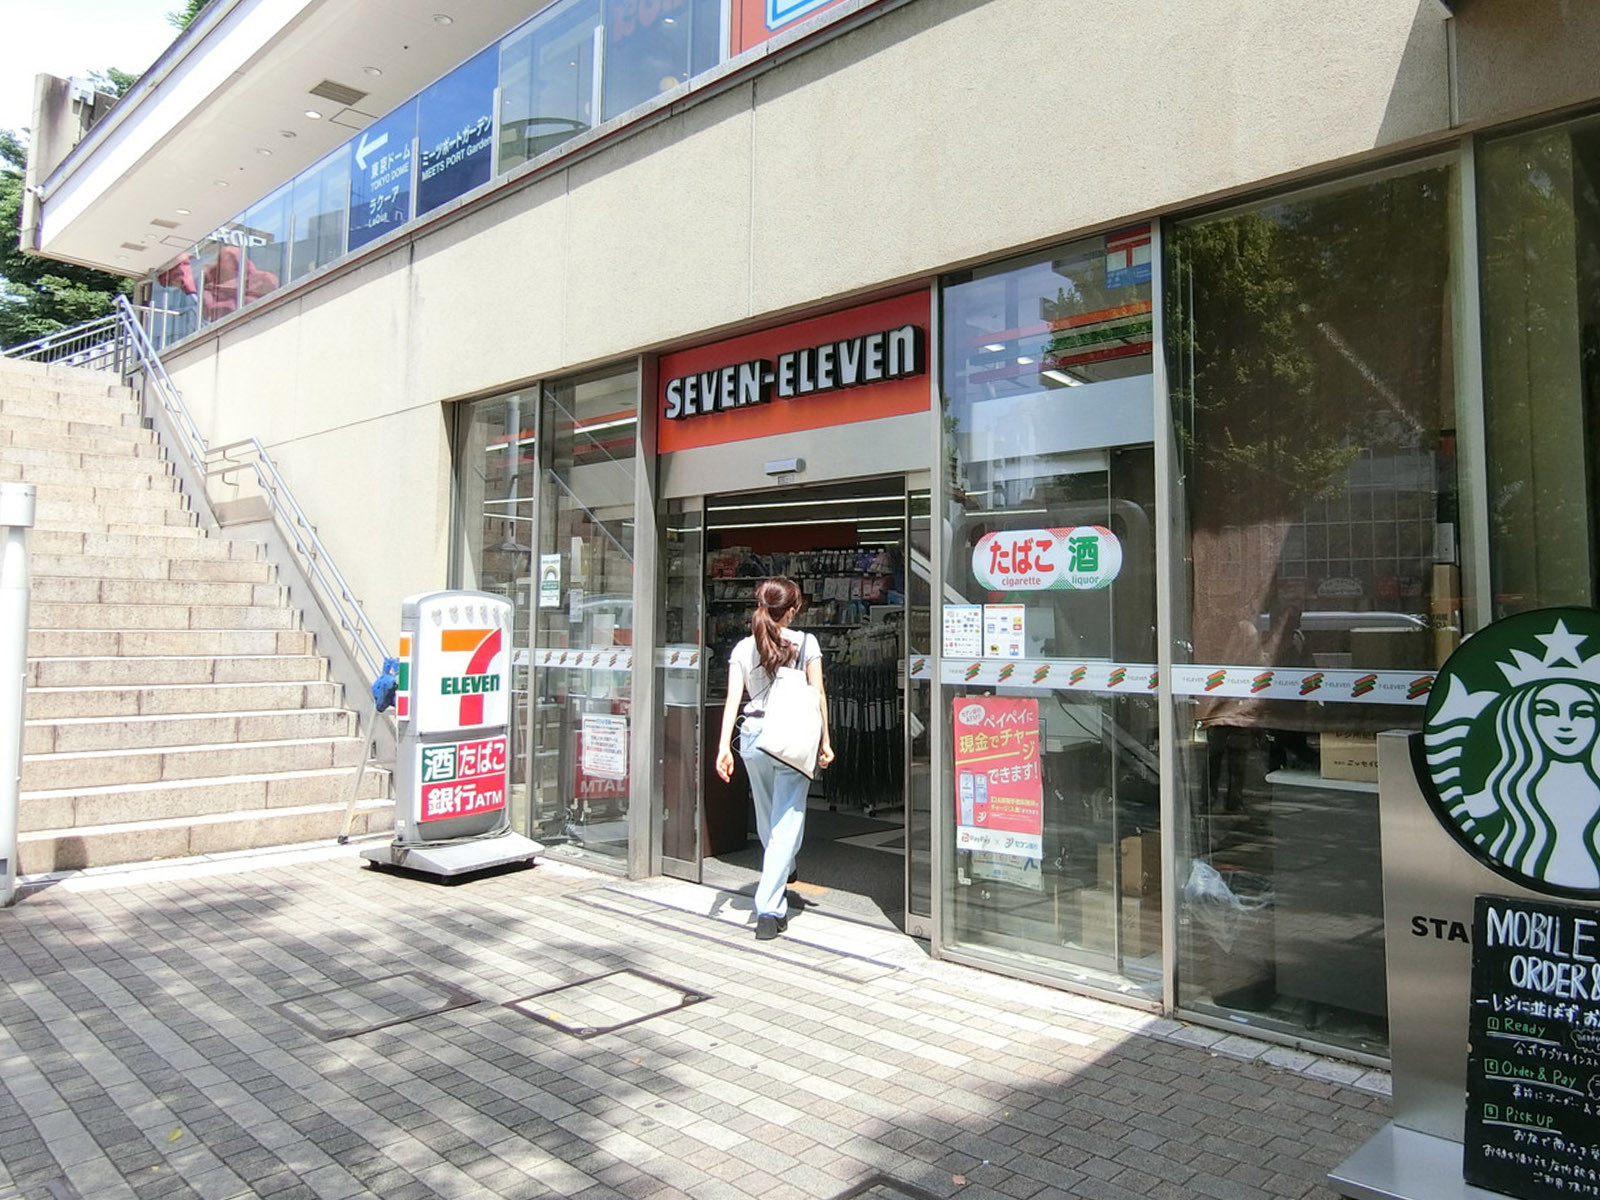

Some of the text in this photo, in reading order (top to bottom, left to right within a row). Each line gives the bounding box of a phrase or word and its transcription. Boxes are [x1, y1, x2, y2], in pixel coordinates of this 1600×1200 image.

[422, 114, 492, 166] ミーツポートガーデン
[370, 143, 411, 180] 東京ドーム
[421, 136, 492, 182] MEETS PORT Garden
[370, 161, 410, 192] TOKYO DOME
[369, 185, 400, 215] ラクーア
[989, 535, 1099, 575] たばこ 酒
[1001, 575, 1100, 586] cigarette liquor
[984, 709, 1033, 728] ペイペイに
[423, 741, 505, 782] 酒 たばこ
[1411, 915, 1470, 944] STA
[1486, 906, 1599, 963] MOBILE
[1504, 1017, 1546, 1038] Ready
[1502, 1060, 1535, 1078] Order
[1537, 1067, 1548, 1082] &
[1553, 1069, 1577, 1089] Pay
[1506, 1106, 1533, 1122] Pick
